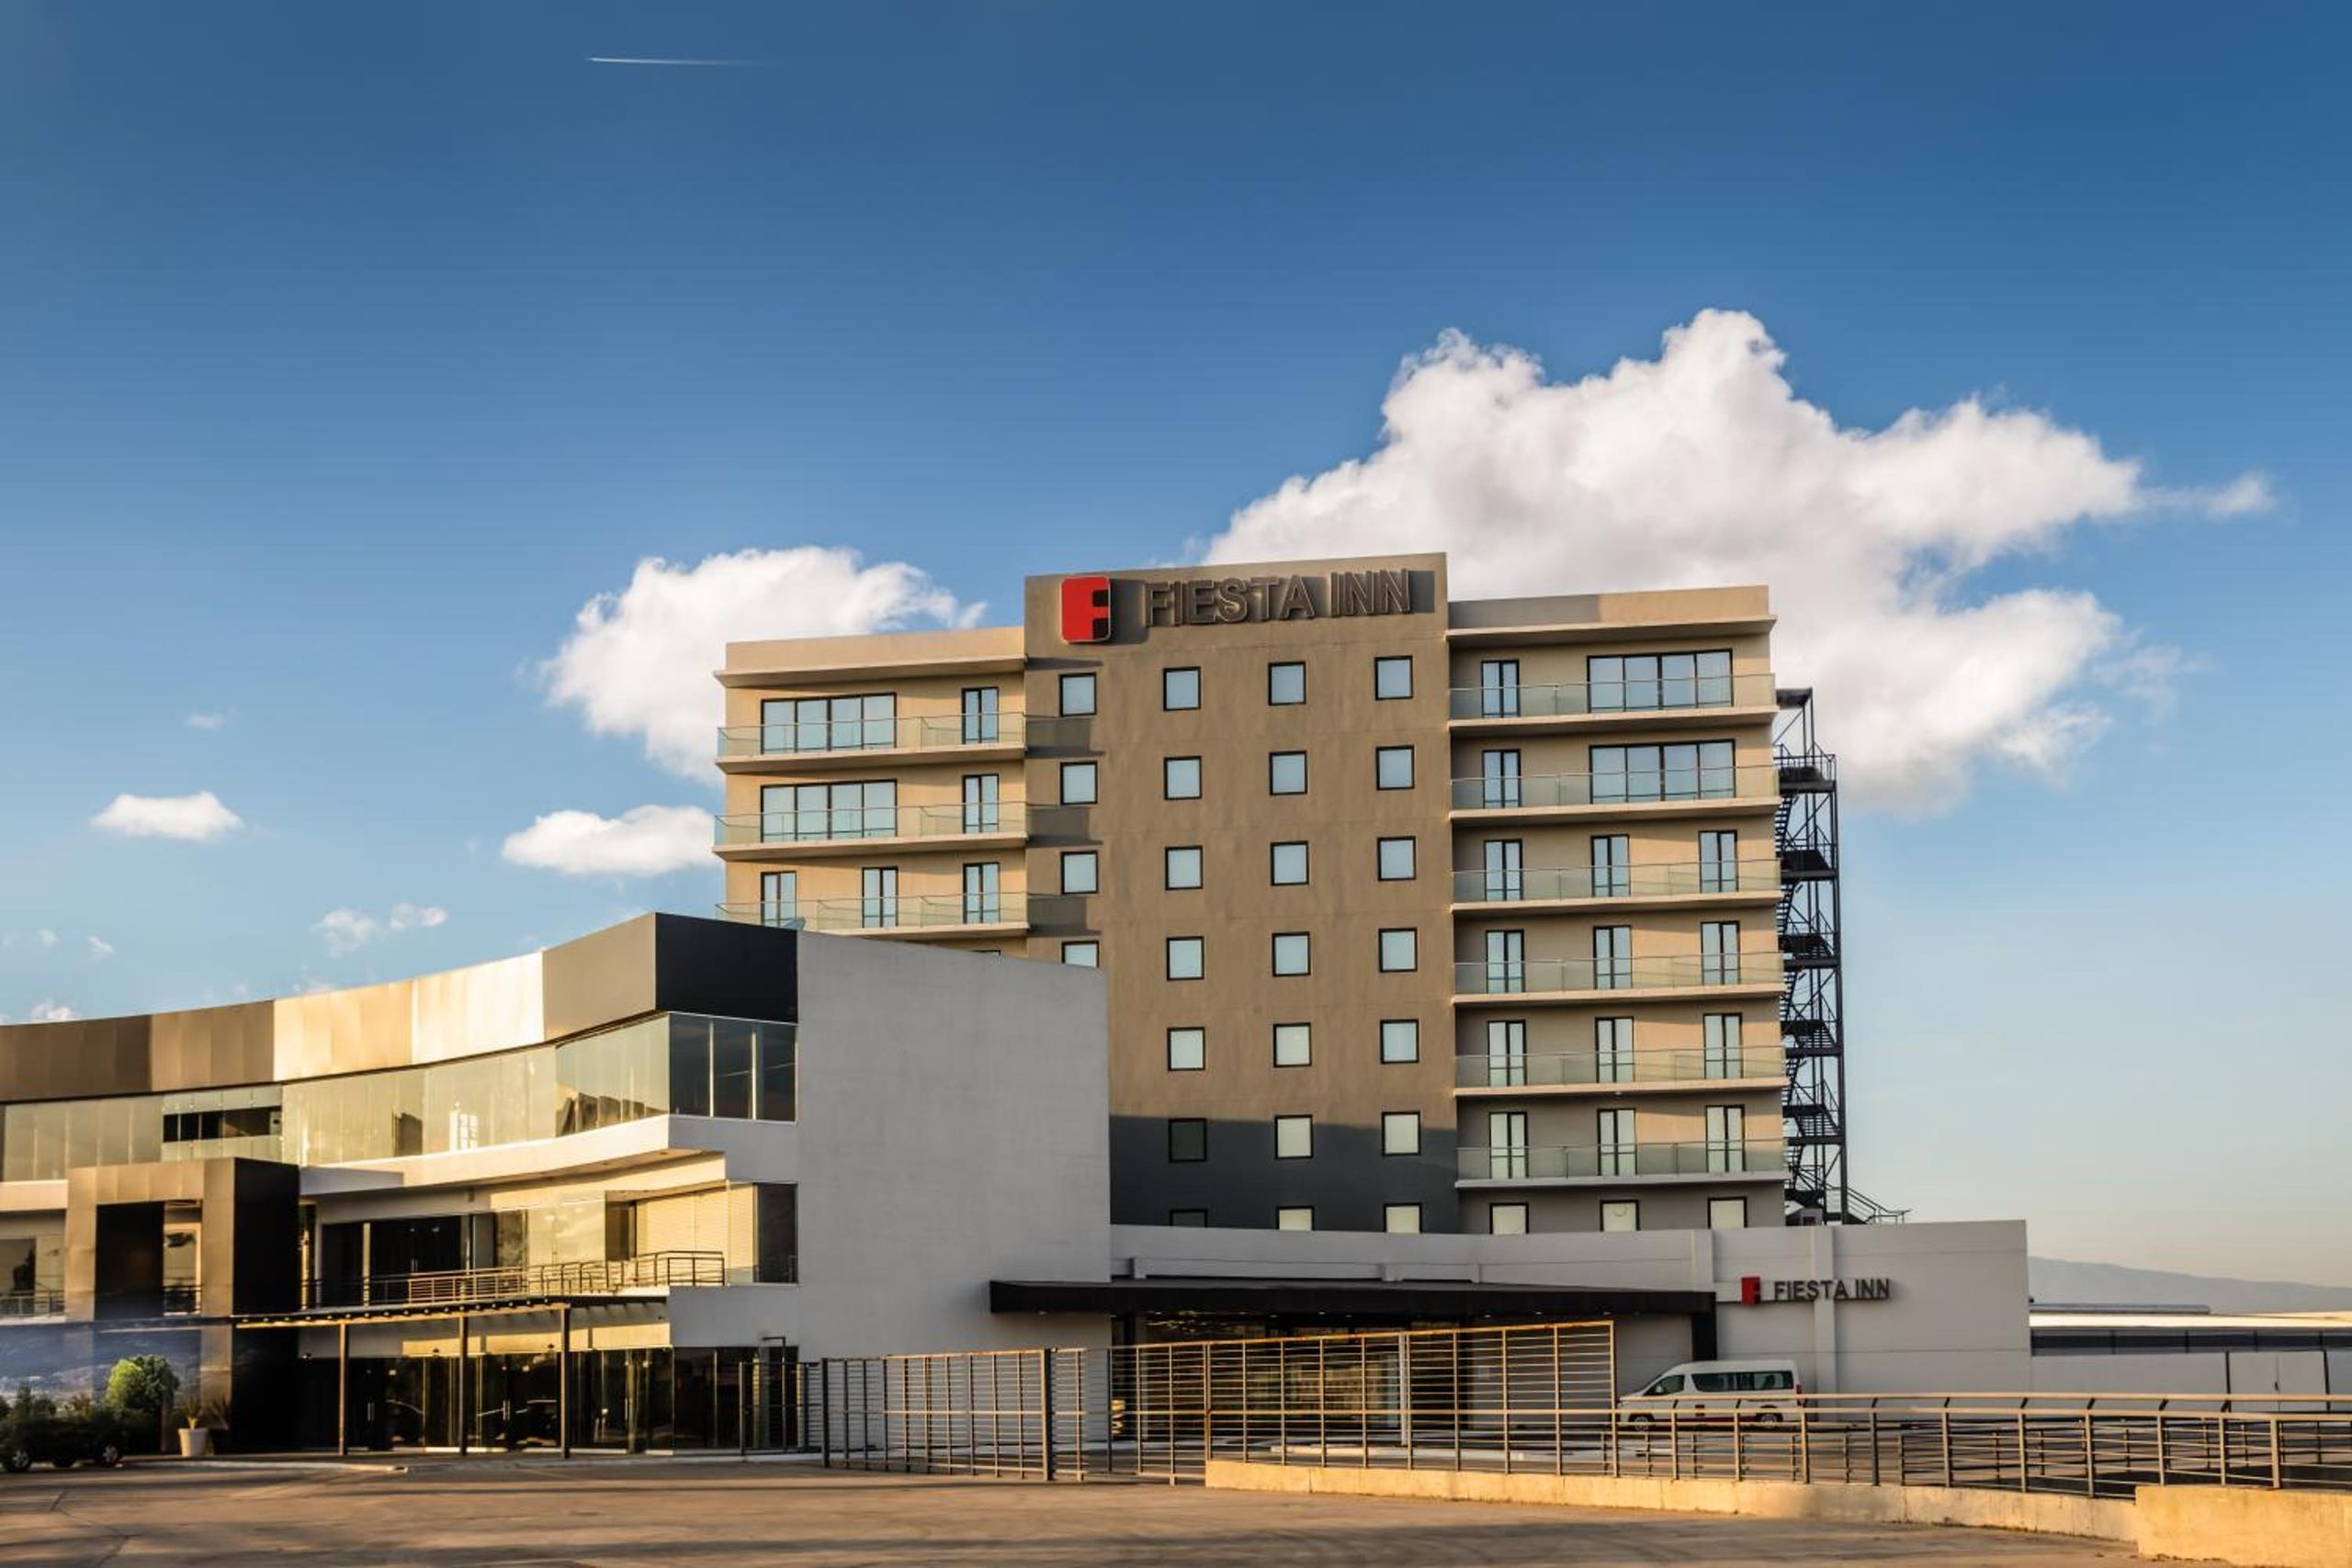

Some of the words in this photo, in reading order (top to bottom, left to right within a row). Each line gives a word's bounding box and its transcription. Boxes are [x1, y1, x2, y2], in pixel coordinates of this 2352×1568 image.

[1144, 574, 1314, 627] FIESTA
[1331, 569, 1410, 616] INN
[1773, 1280, 1848, 1301] FIESTA
[1854, 1278, 1890, 1300] INN
